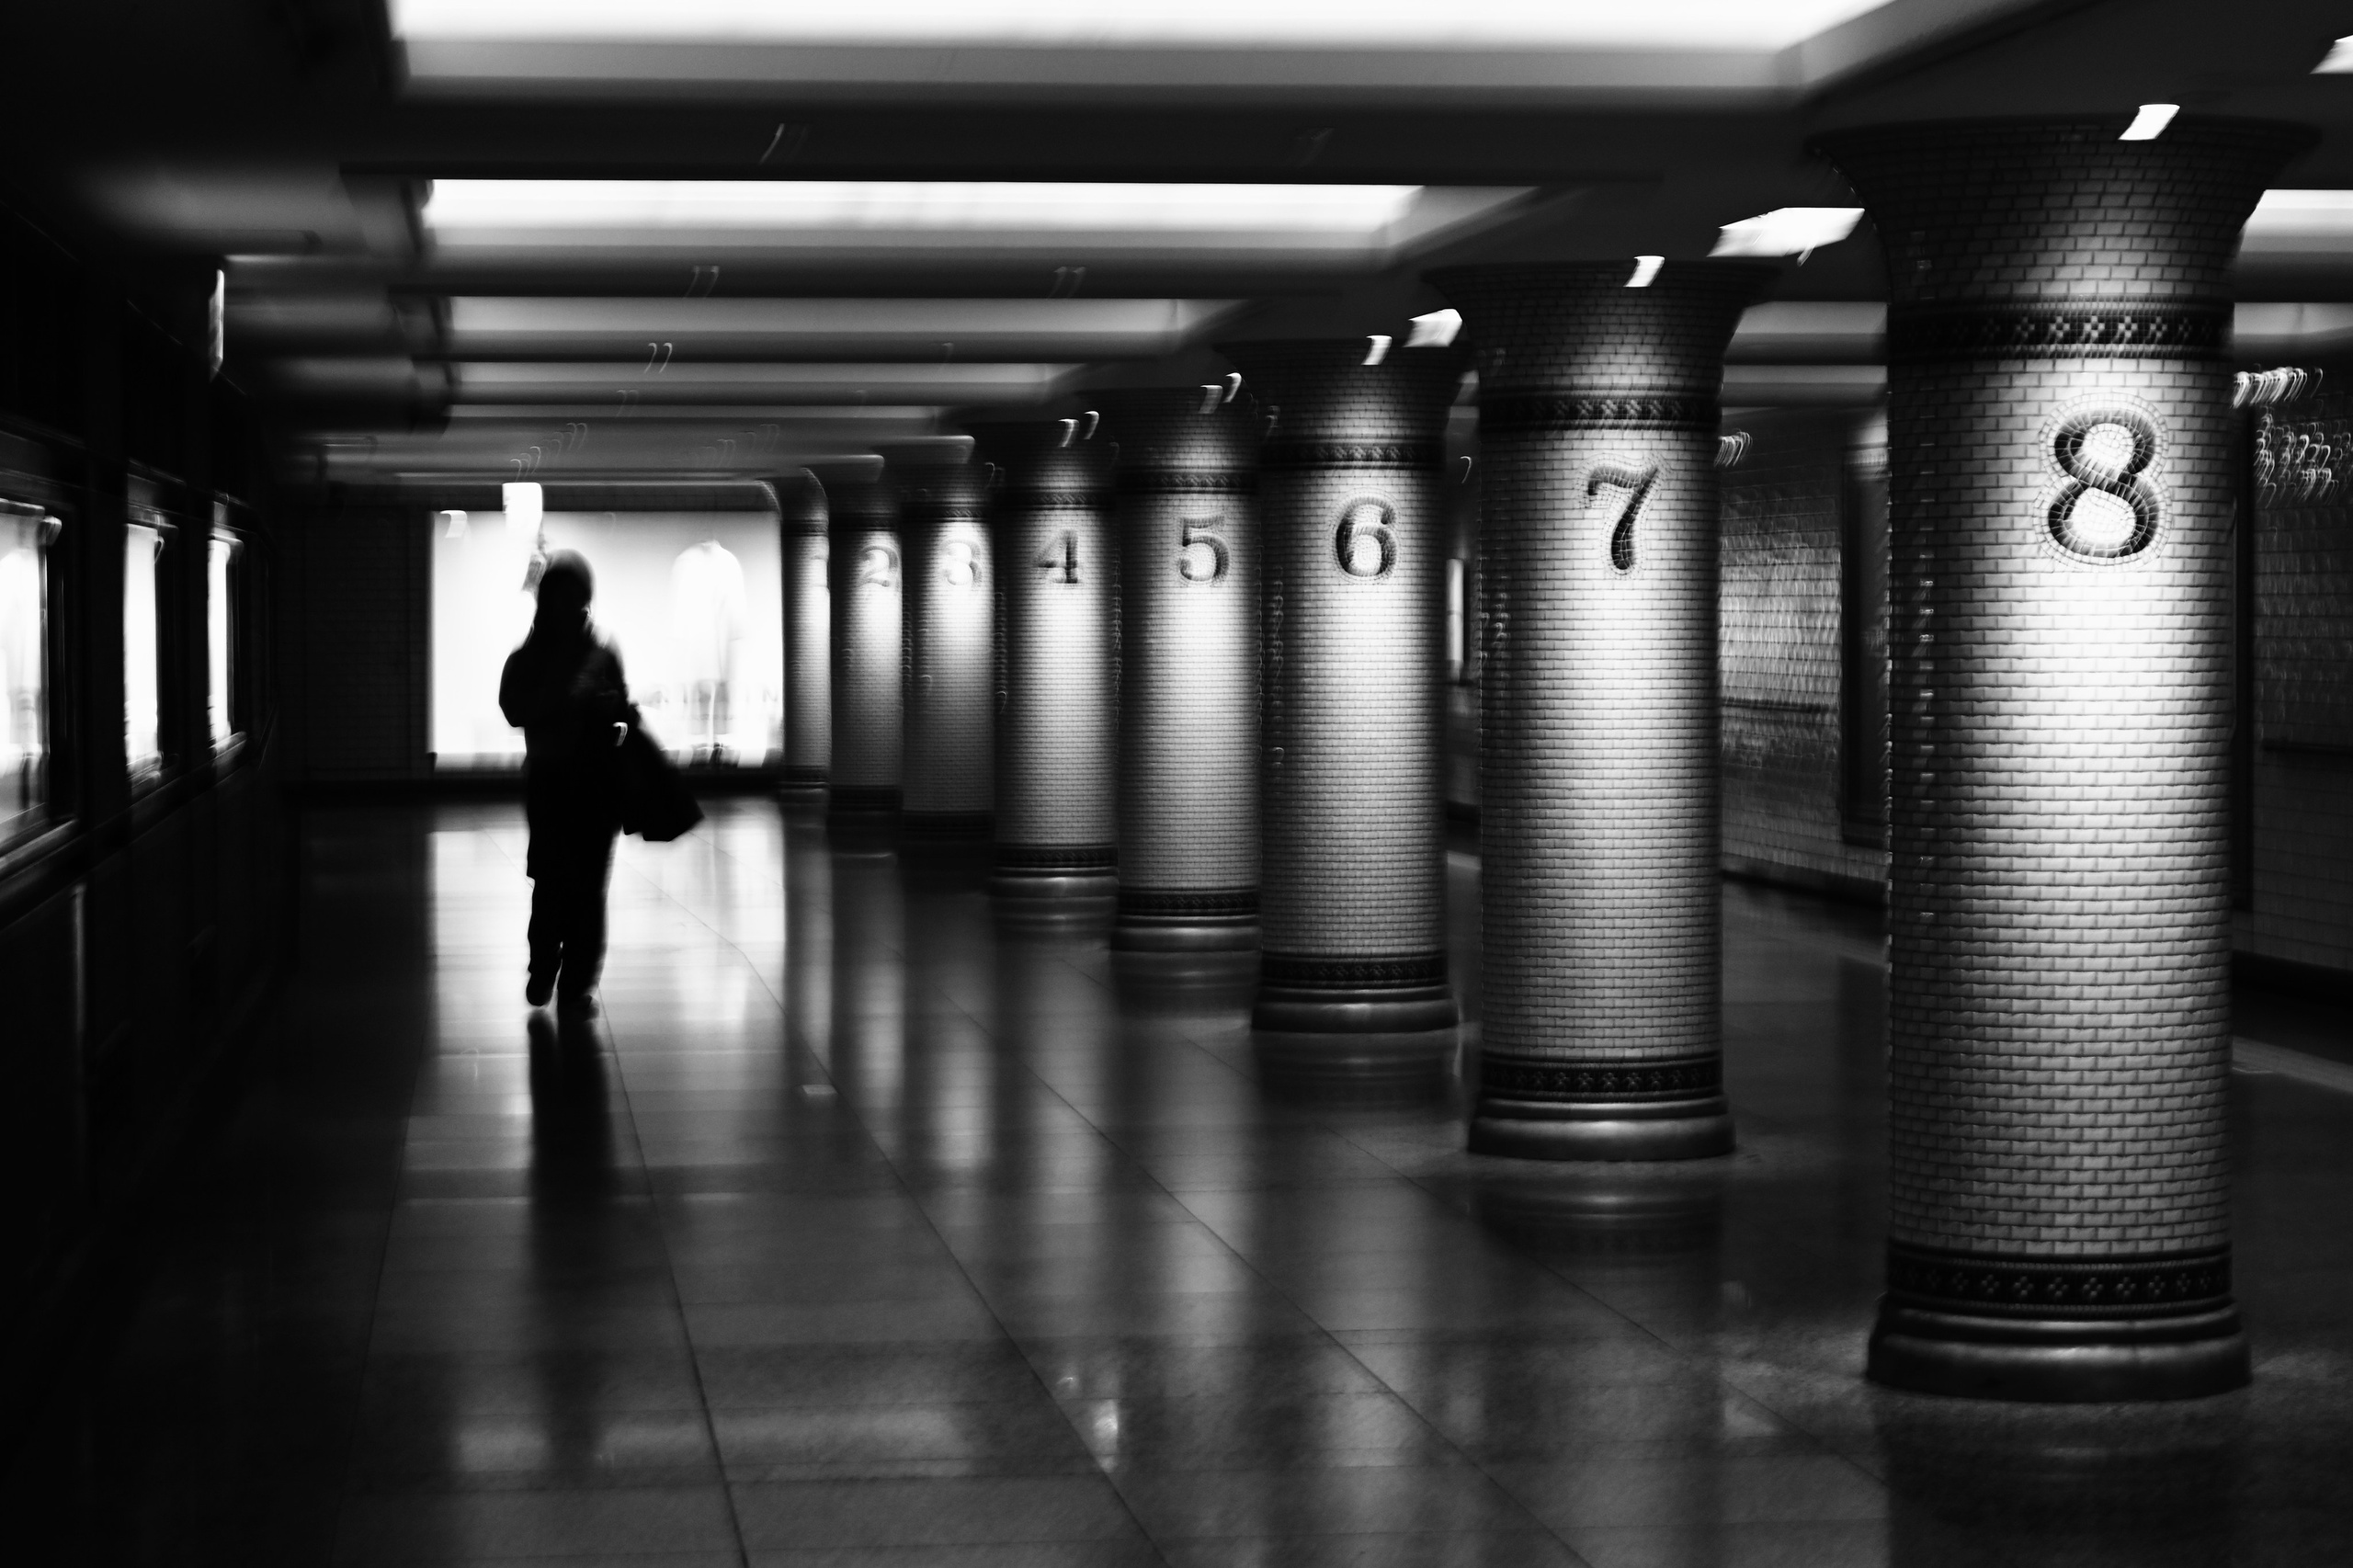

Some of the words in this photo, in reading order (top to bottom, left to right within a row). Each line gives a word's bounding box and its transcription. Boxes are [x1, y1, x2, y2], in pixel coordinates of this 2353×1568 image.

[1586, 461, 1657, 571] 7
[2048, 409, 2160, 558] 8
[858, 542, 901, 587] 2
[943, 539, 983, 586] 3
[1030, 529, 1079, 585] 4
[1179, 517, 1230, 582] 5
[1336, 499, 1396, 577] 6
